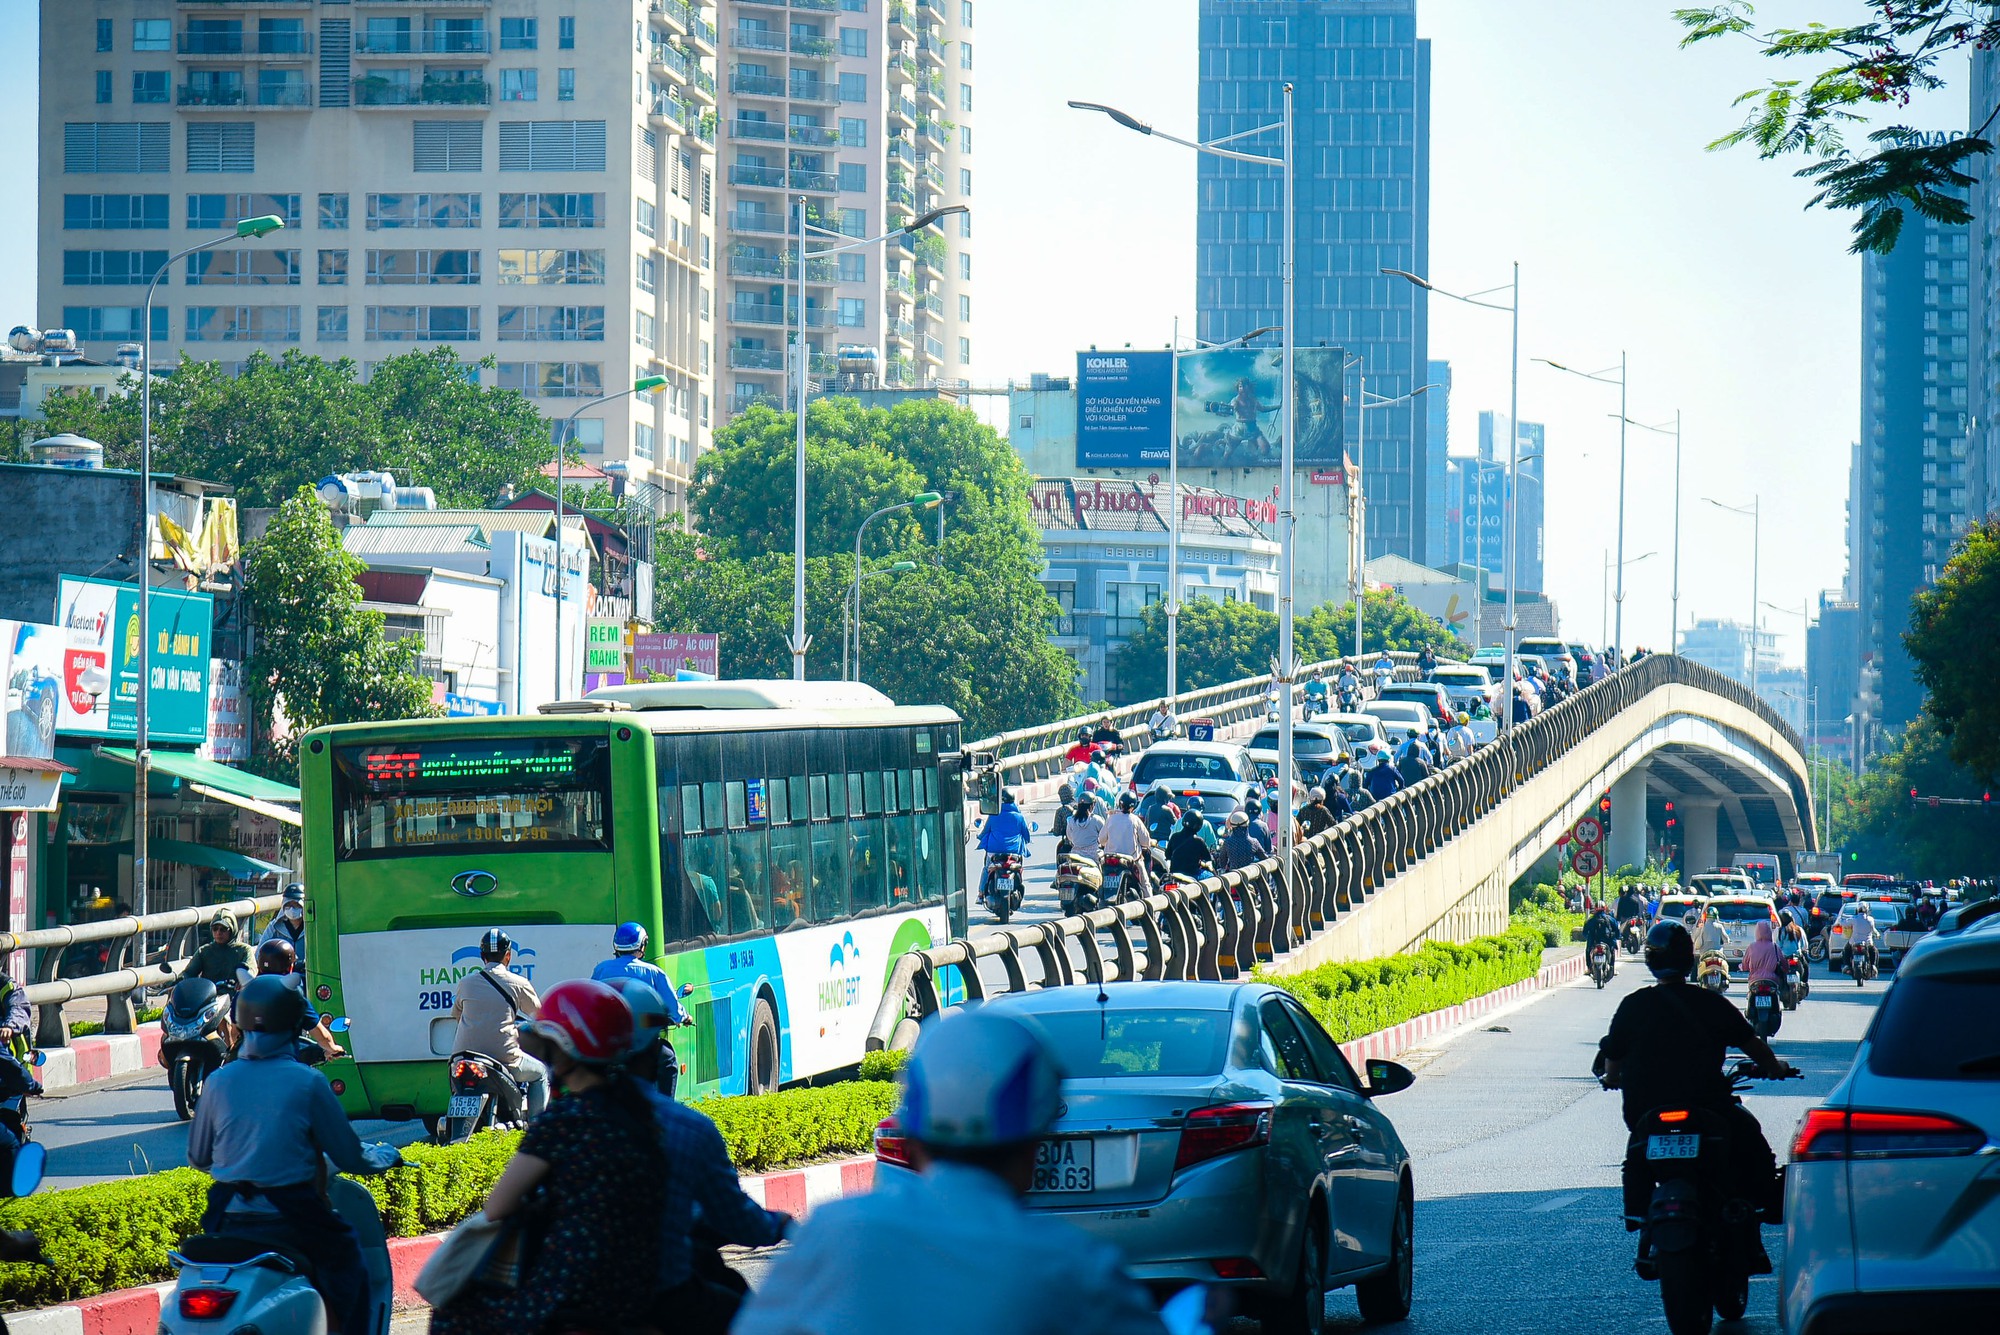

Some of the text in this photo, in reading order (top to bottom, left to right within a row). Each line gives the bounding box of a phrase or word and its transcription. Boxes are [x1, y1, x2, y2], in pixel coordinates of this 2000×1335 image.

[1086, 358, 1127, 368] KOHLER
[1075, 480, 1156, 521] phuoc
[1183, 487, 1238, 521] pierre
[1245, 495, 1278, 524] cardin
[1465, 515, 1500, 526] GAO
[157, 628, 169, 654] XÔI
[173, 630, 190, 656] BÁNH
[698, 638, 715, 651] QUY
[406, 827, 548, 843] Hotline 1900 1296
[450, 1106, 478, 1117] 005.23
[1658, 1135, 1693, 1146] 15-B3
[1036, 1142, 1075, 1165] 30A
[1026, 1167, 1090, 1190] 86.63
